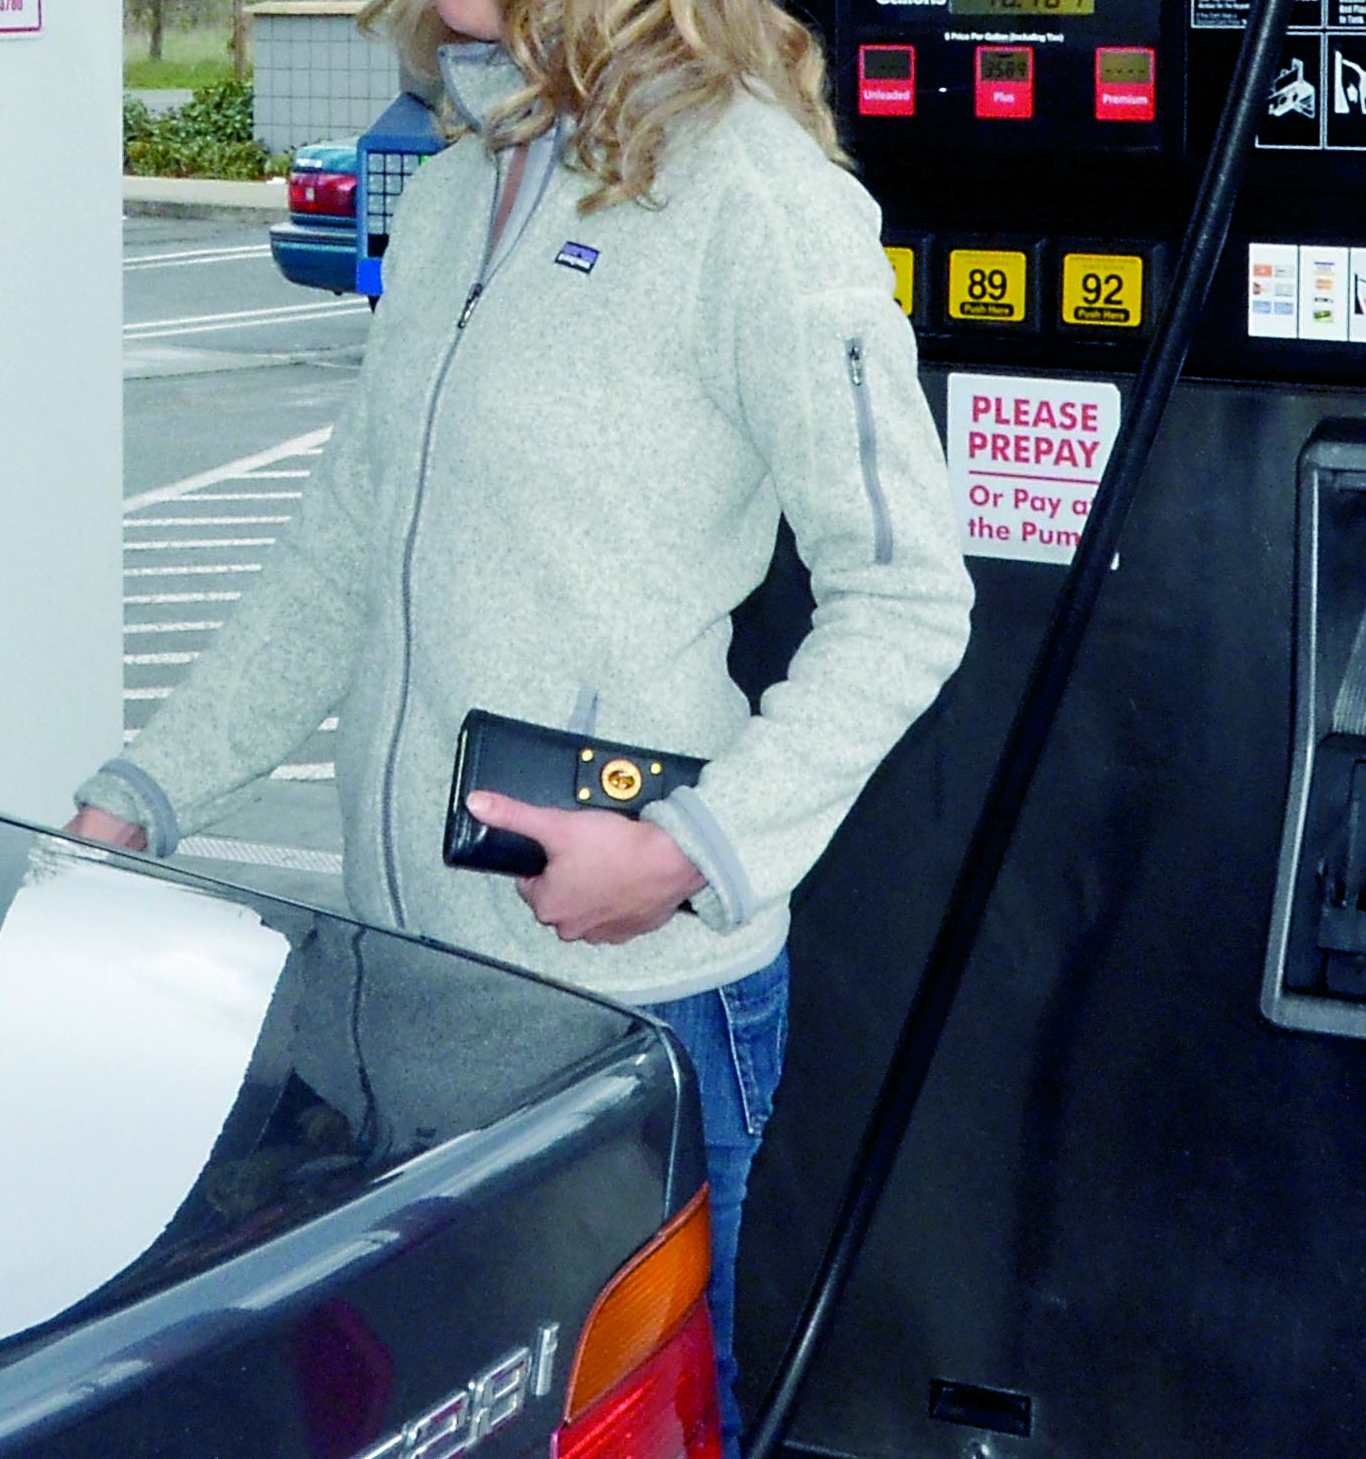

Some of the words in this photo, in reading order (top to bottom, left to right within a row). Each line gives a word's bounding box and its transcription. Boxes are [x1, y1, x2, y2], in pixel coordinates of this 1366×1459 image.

[994, 92, 1015, 103] Plus
[1102, 93, 1148, 105] Premium
[968, 269, 1007, 301] 89
[1082, 273, 1123, 305] 92
[965, 304, 984, 315] Push
[986, 305, 1010, 316] Here
[1078, 309, 1100, 320] Push
[1102, 311, 1126, 322] Here
[972, 395, 1098, 432] PLEASE
[969, 431, 1100, 469] PREPAY
[969, 484, 1004, 507] Or
[1014, 488, 1061, 518] Pay
[1072, 498, 1092, 515] a
[968, 517, 1010, 541] the
[1022, 521, 1081, 546] Pum
